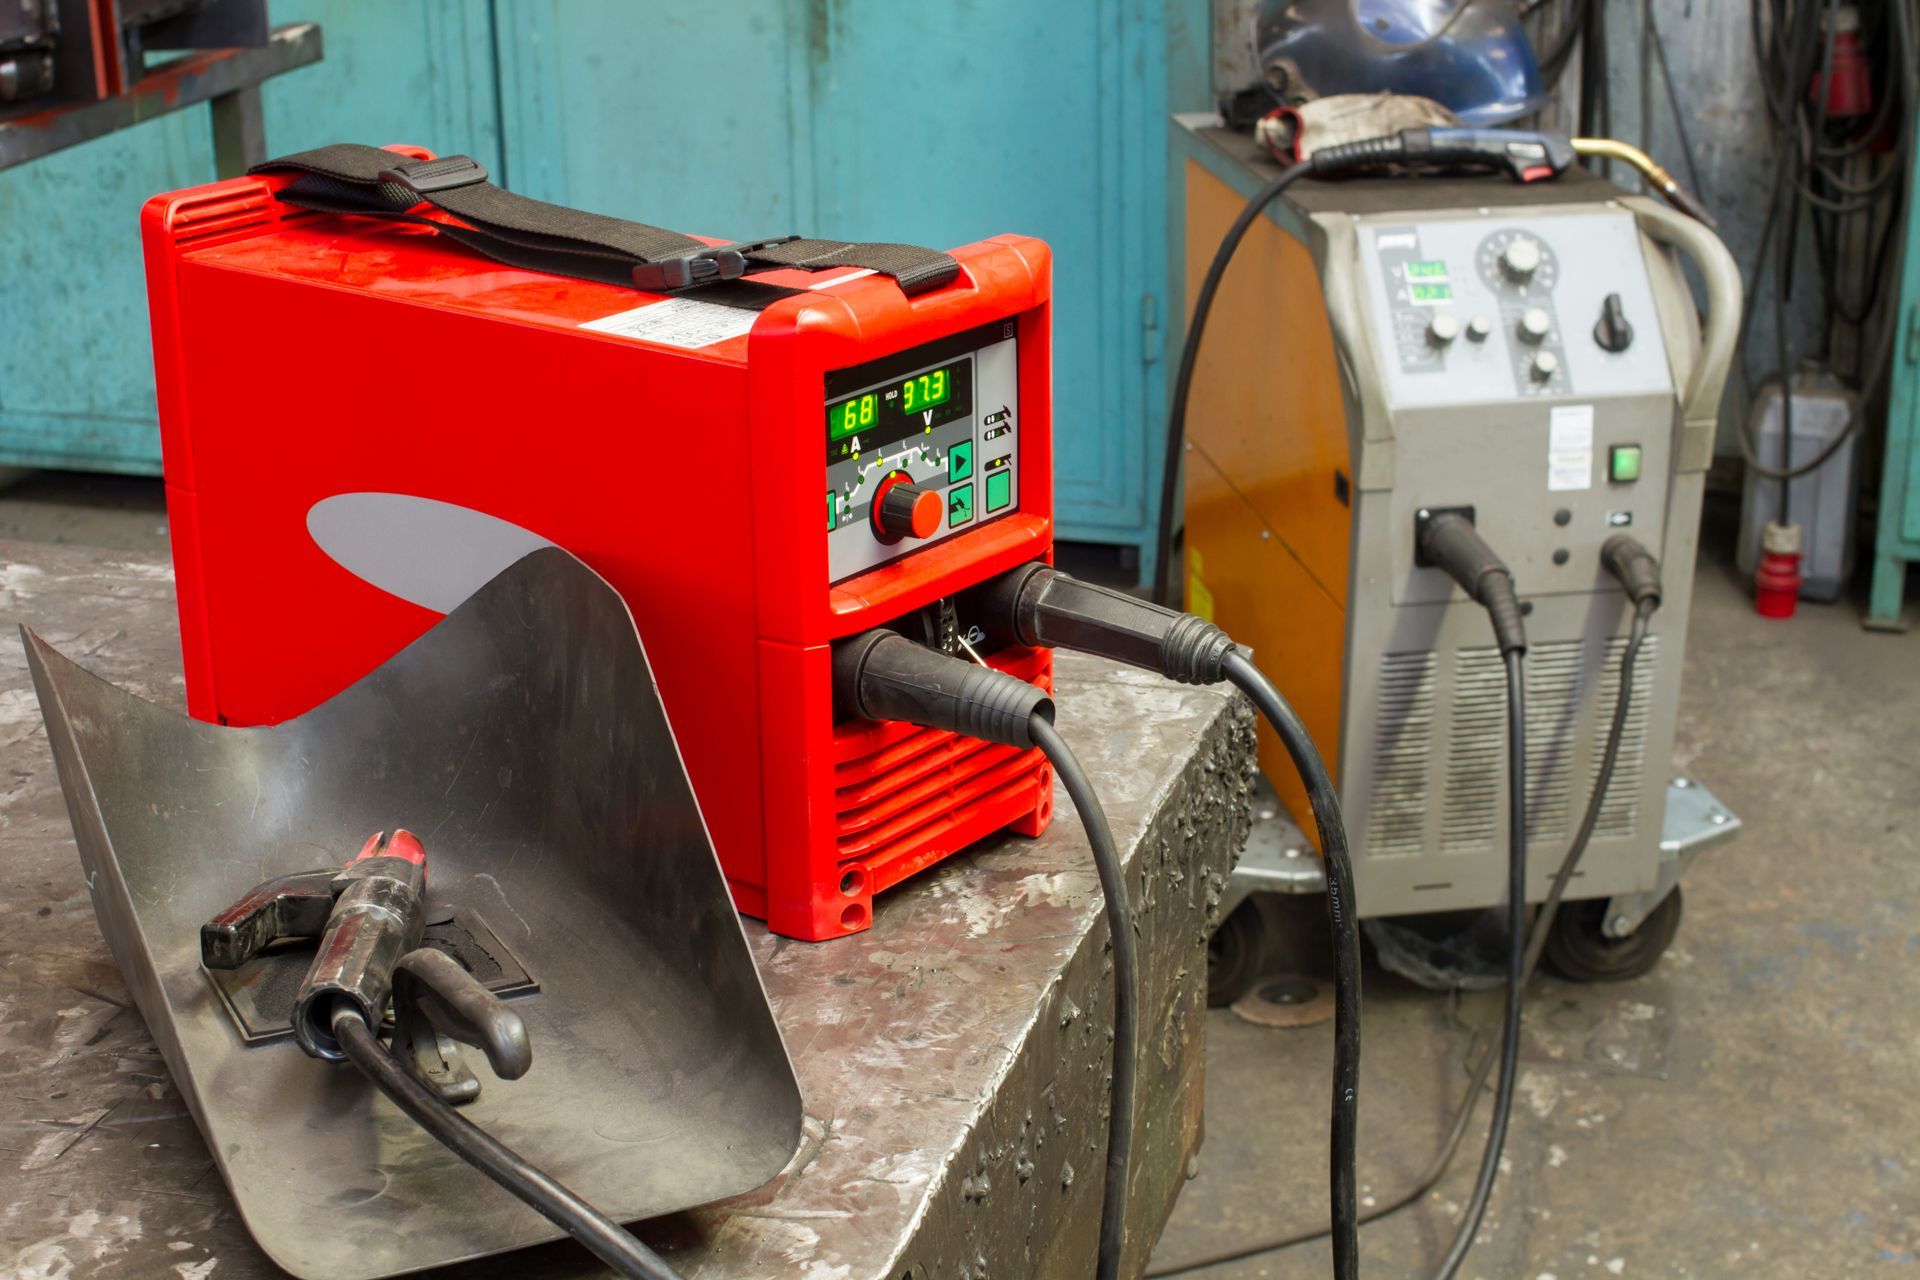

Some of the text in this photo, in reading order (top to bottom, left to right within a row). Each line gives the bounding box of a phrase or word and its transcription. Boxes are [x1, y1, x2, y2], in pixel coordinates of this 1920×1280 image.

[885, 390, 898, 401] HOLD
[844, 394, 873, 430] 68
[923, 409, 933, 426] V
[850, 435, 861, 453] A
